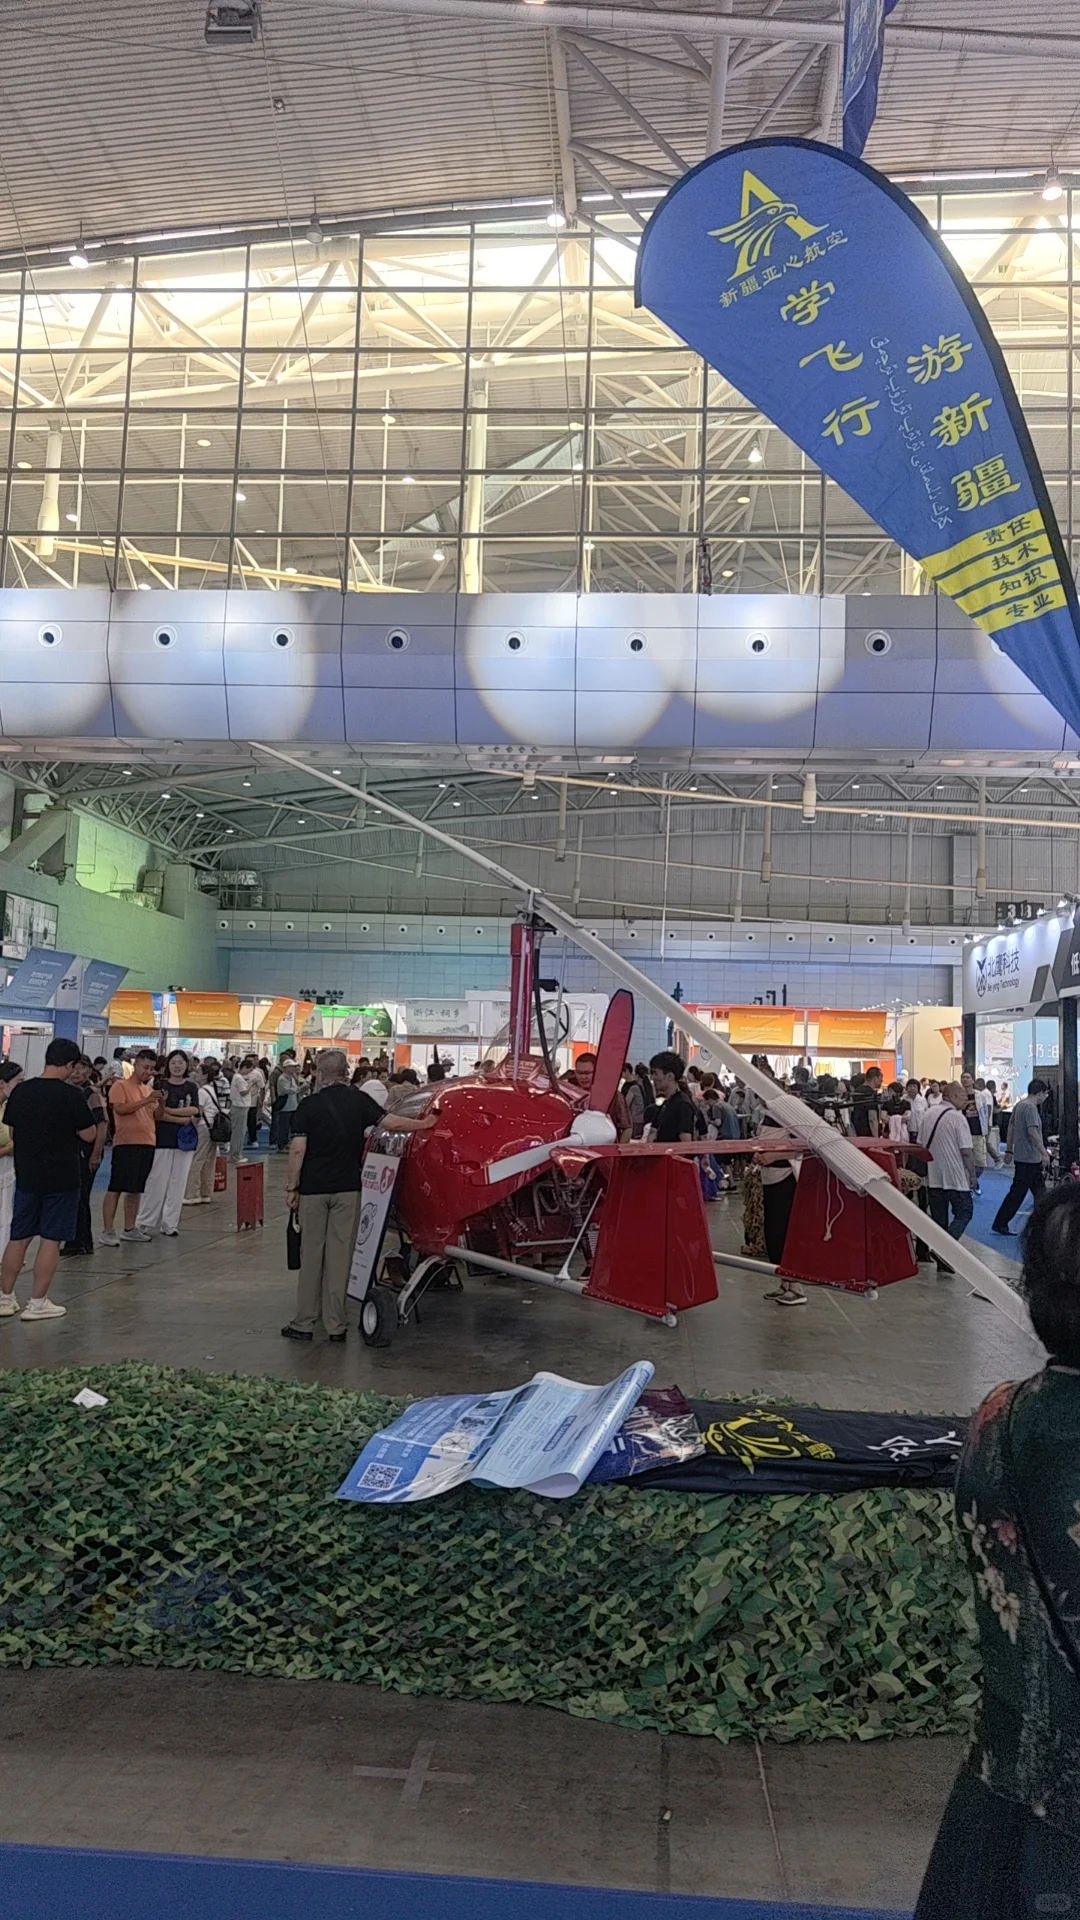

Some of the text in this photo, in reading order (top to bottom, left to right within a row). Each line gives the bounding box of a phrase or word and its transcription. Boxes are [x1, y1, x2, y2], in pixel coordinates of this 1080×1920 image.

[718, 229, 849, 309] 新疆亚心航空
[780, 279, 880, 446] 学飞行
[906, 332, 1021, 512] 游新疆
[982, 517, 1031, 545] 责任
[991, 542, 1039, 571] 技术
[999, 566, 1047, 595] 知识
[1005, 593, 1054, 617] 专业
[988, 949, 1020, 979] 北鹰科技
[1071, 952, 1080, 976] 低
